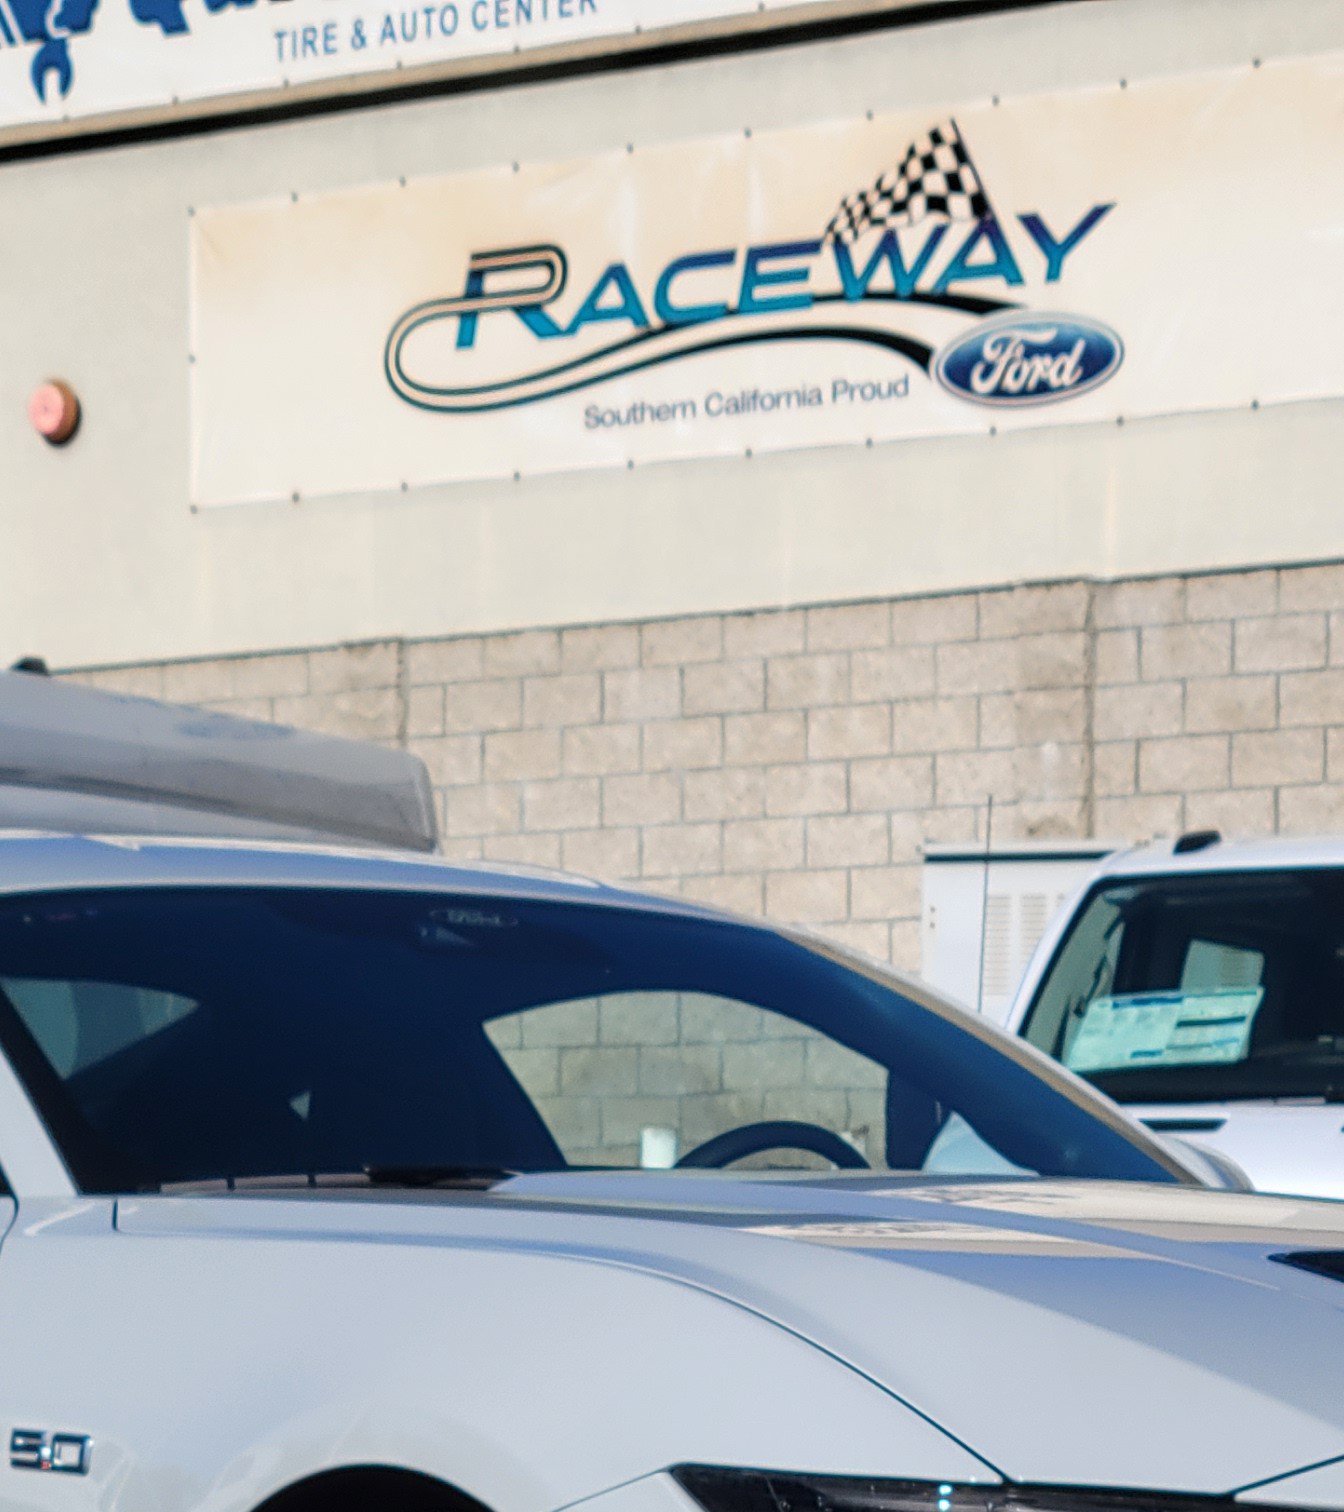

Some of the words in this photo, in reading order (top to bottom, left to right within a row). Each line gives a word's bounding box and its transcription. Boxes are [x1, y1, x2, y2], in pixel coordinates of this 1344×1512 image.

[274, 23, 338, 62] TIRE
[350, 18, 367, 50] &
[380, 5, 459, 46] AUTO
[454, 202, 1118, 351] RACEWAY
[972, 330, 1086, 396] Ford
[583, 401, 697, 430] Southern
[704, 385, 824, 418] California
[831, 373, 911, 404] Proud
